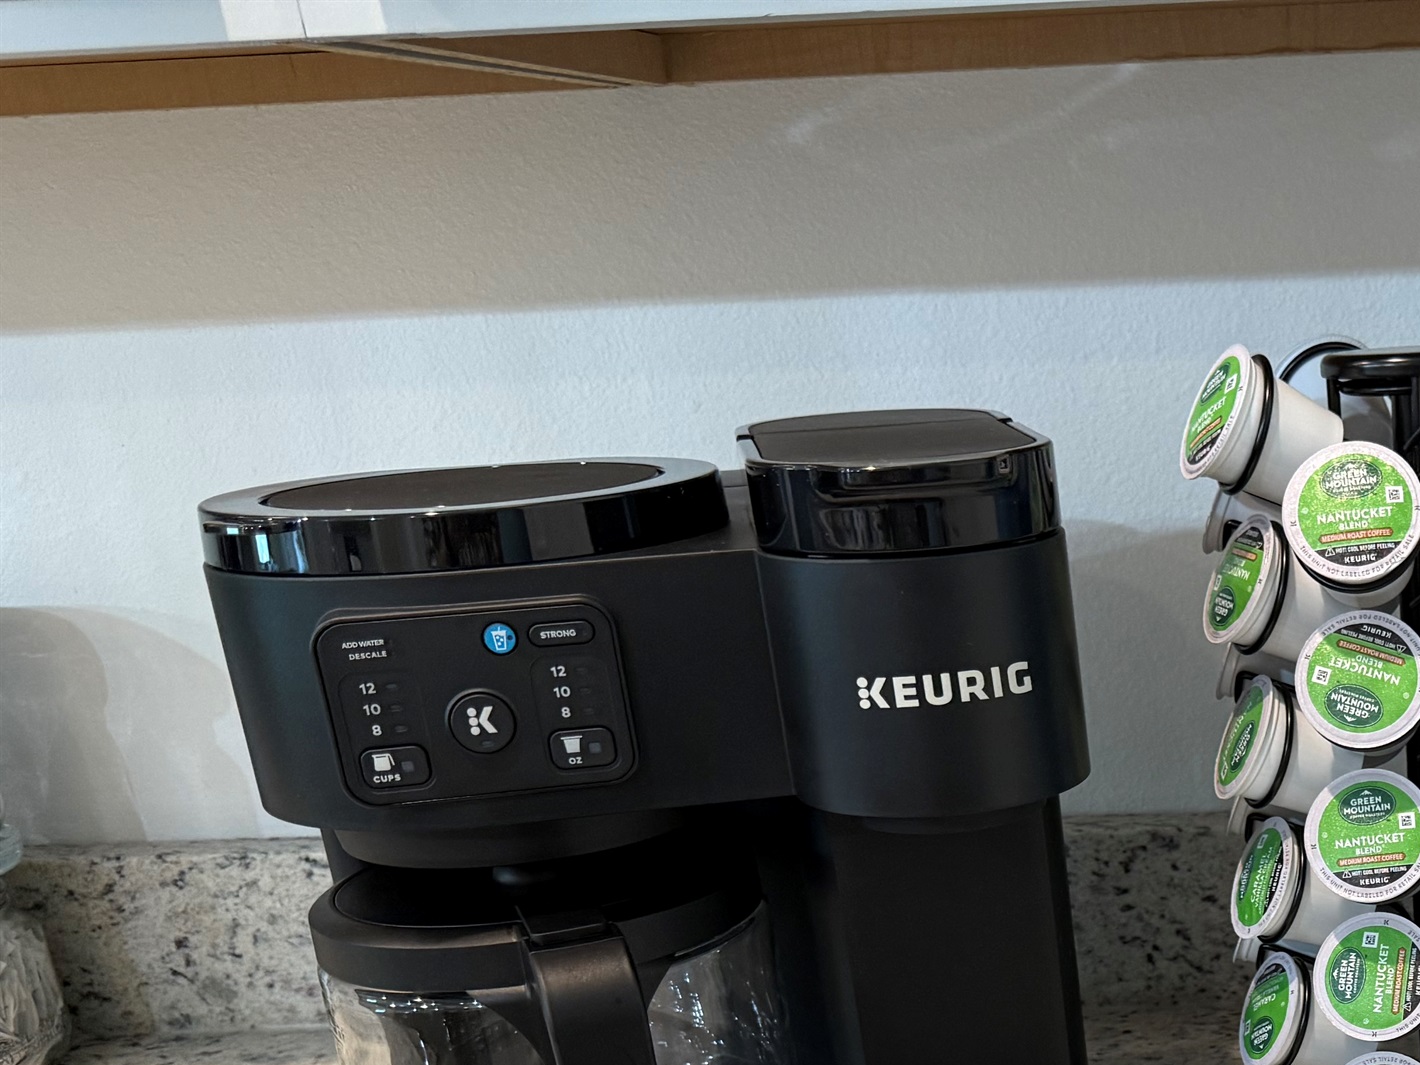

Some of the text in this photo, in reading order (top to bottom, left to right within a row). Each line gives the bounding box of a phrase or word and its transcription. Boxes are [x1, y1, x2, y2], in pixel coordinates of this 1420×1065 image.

[1331, 467, 1367, 480] GREEN
[1324, 474, 1376, 490] MOUNTAIN
[1316, 505, 1393, 525] NANTUCKET
[1337, 519, 1368, 530] BLEND
[1344, 553, 1375, 563] KEURIG
[540, 628, 577, 640] STRONG
[1361, 624, 1391, 638] KEURIG
[341, 638, 385, 650] ADD WATER
[348, 650, 388, 661] DESCALE
[1354, 653, 1383, 668] BLEND
[550, 665, 567, 678] 12
[1328, 655, 1400, 685] NANTUCKET
[359, 682, 377, 696] 12
[553, 686, 571, 698] 10
[856, 661, 1033, 710] KEURIG
[1329, 691, 1379, 713] MOUNTAIN
[363, 703, 382, 717] 10
[561, 706, 571, 719] 8
[1336, 702, 1369, 718] GREEN
[371, 725, 383, 737] 8
[568, 756, 584, 765] OZ
[373, 773, 402, 784] CUPS
[1349, 796, 1381, 806] GREEN
[1343, 802, 1390, 815] MOUNTAIN
[1334, 832, 1406, 848] NANTUCKET
[1355, 845, 1382, 855] BLEND
[1359, 876, 1389, 885] KEURIG
[1337, 959, 1348, 990] GREEN
[1344, 952, 1356, 999] MOUNTAIN
[1372, 943, 1389, 1013] NANTUCKET
[1385, 966, 1394, 994] BLEND
